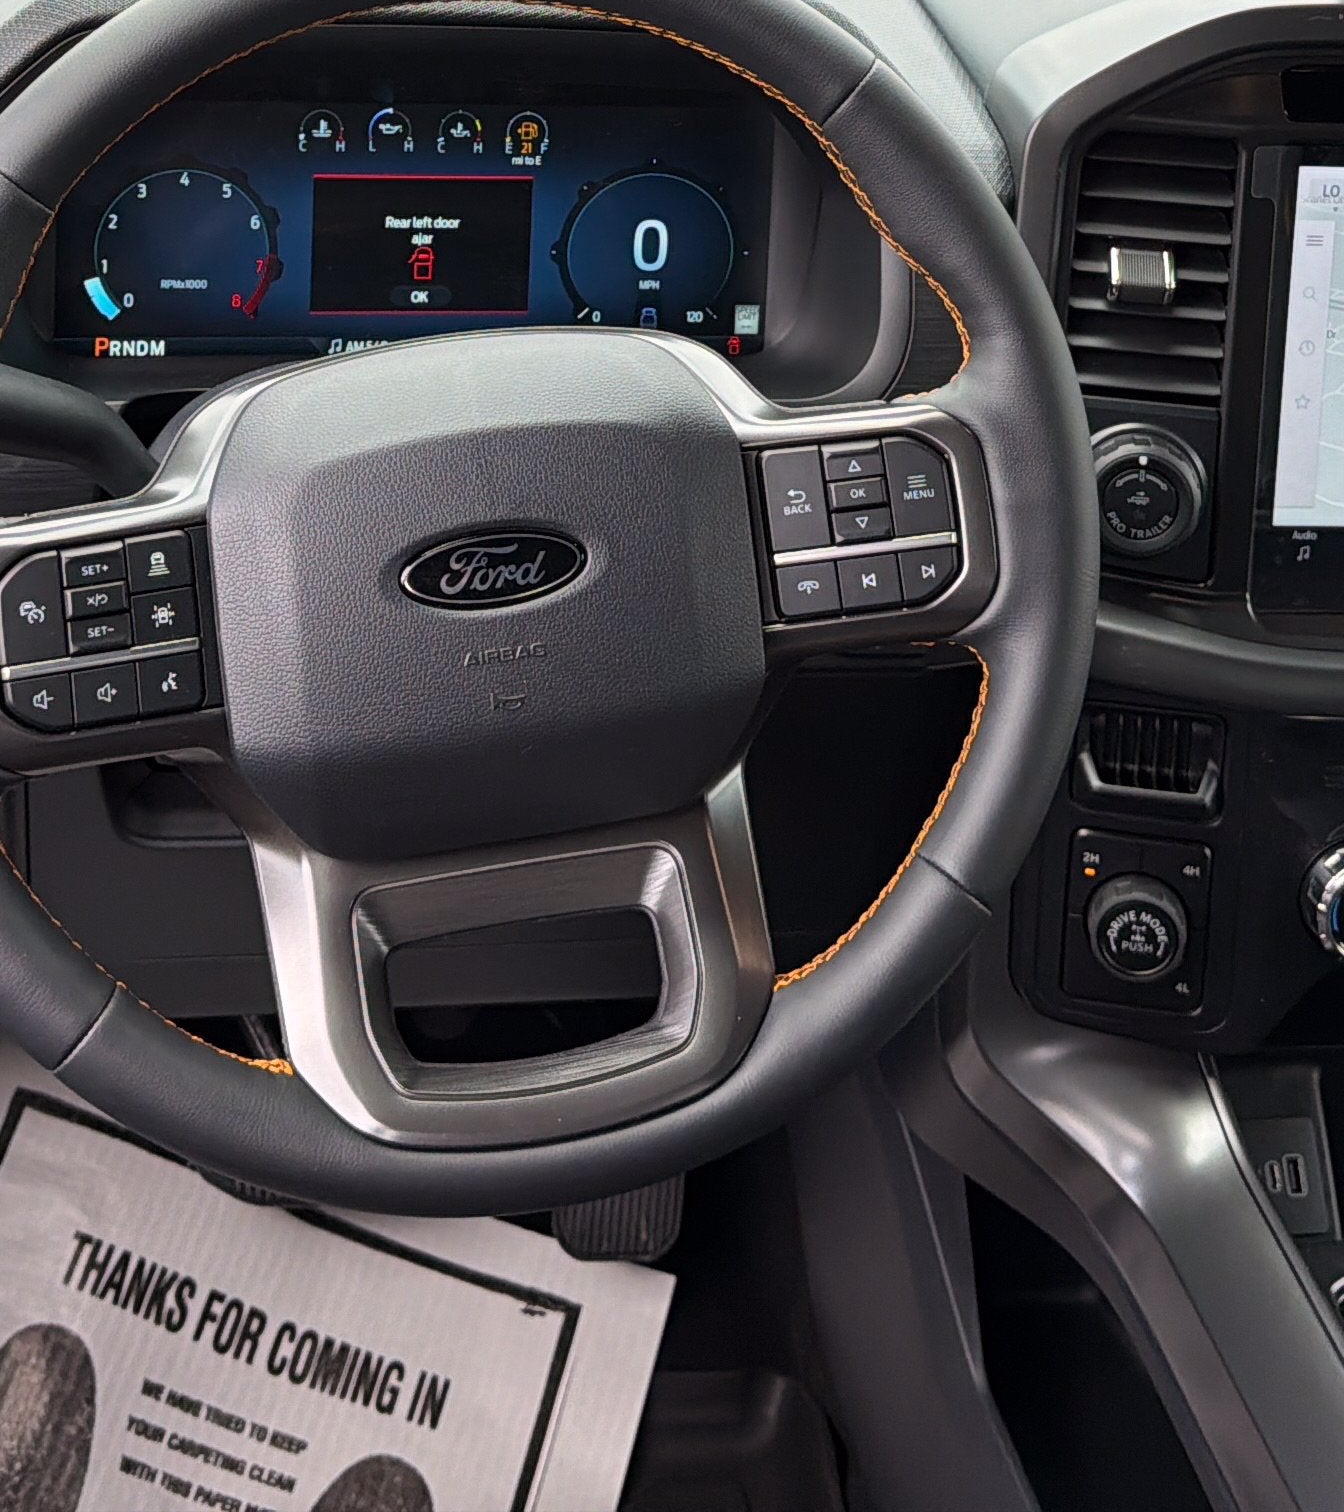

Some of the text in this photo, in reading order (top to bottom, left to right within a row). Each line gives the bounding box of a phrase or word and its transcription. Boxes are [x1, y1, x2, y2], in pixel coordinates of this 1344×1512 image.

[299, 141, 345, 152] C H
[369, 141, 414, 152] L H
[438, 141, 483, 153] C H
[505, 142, 548, 154] E 21 F
[180, 172, 190, 186] 4
[137, 184, 146, 198] 3
[222, 184, 232, 198] 5
[1322, 184, 1340, 198] LO
[108, 215, 117, 229] 2
[251, 215, 260, 229] 6
[385, 216, 460, 229] Rear left door
[411, 233, 434, 246] ajar
[633, 219, 668, 271] 0
[101, 259, 108, 273] 1
[256, 260, 263, 273] 7
[639, 280, 659, 289] MPH
[123, 293, 134, 307] 0
[232, 295, 241, 308] 8
[411, 291, 428, 303] OK
[592, 311, 600, 322] 0
[687, 311, 703, 322] 120
[850, 488, 866, 499] OK
[903, 488, 934, 501] MENU
[783, 503, 812, 516] BACK
[1106, 510, 1173, 539] PRO TRAILER
[1292, 530, 1317, 541] Audio
[81, 564, 109, 576] SET+
[440, 542, 546, 595] Ford
[87, 626, 115, 638] SET-
[463, 642, 546, 667] AIRBAG
[1083, 851, 1100, 864] 2H
[1183, 865, 1200, 877] 4H
[1107, 910, 1169, 943] DRIVE MODE
[1121, 940, 1153, 953] PUSH
[63, 1230, 452, 1431] THANKS FOR COMING IN
[141, 1377, 165, 1401] WE
[249, 1421, 268, 1442] TO
[127, 1414, 166, 1442] YOUR
[249, 1463, 297, 1493] CLEAN
[119, 1454, 158, 1483] WITH
